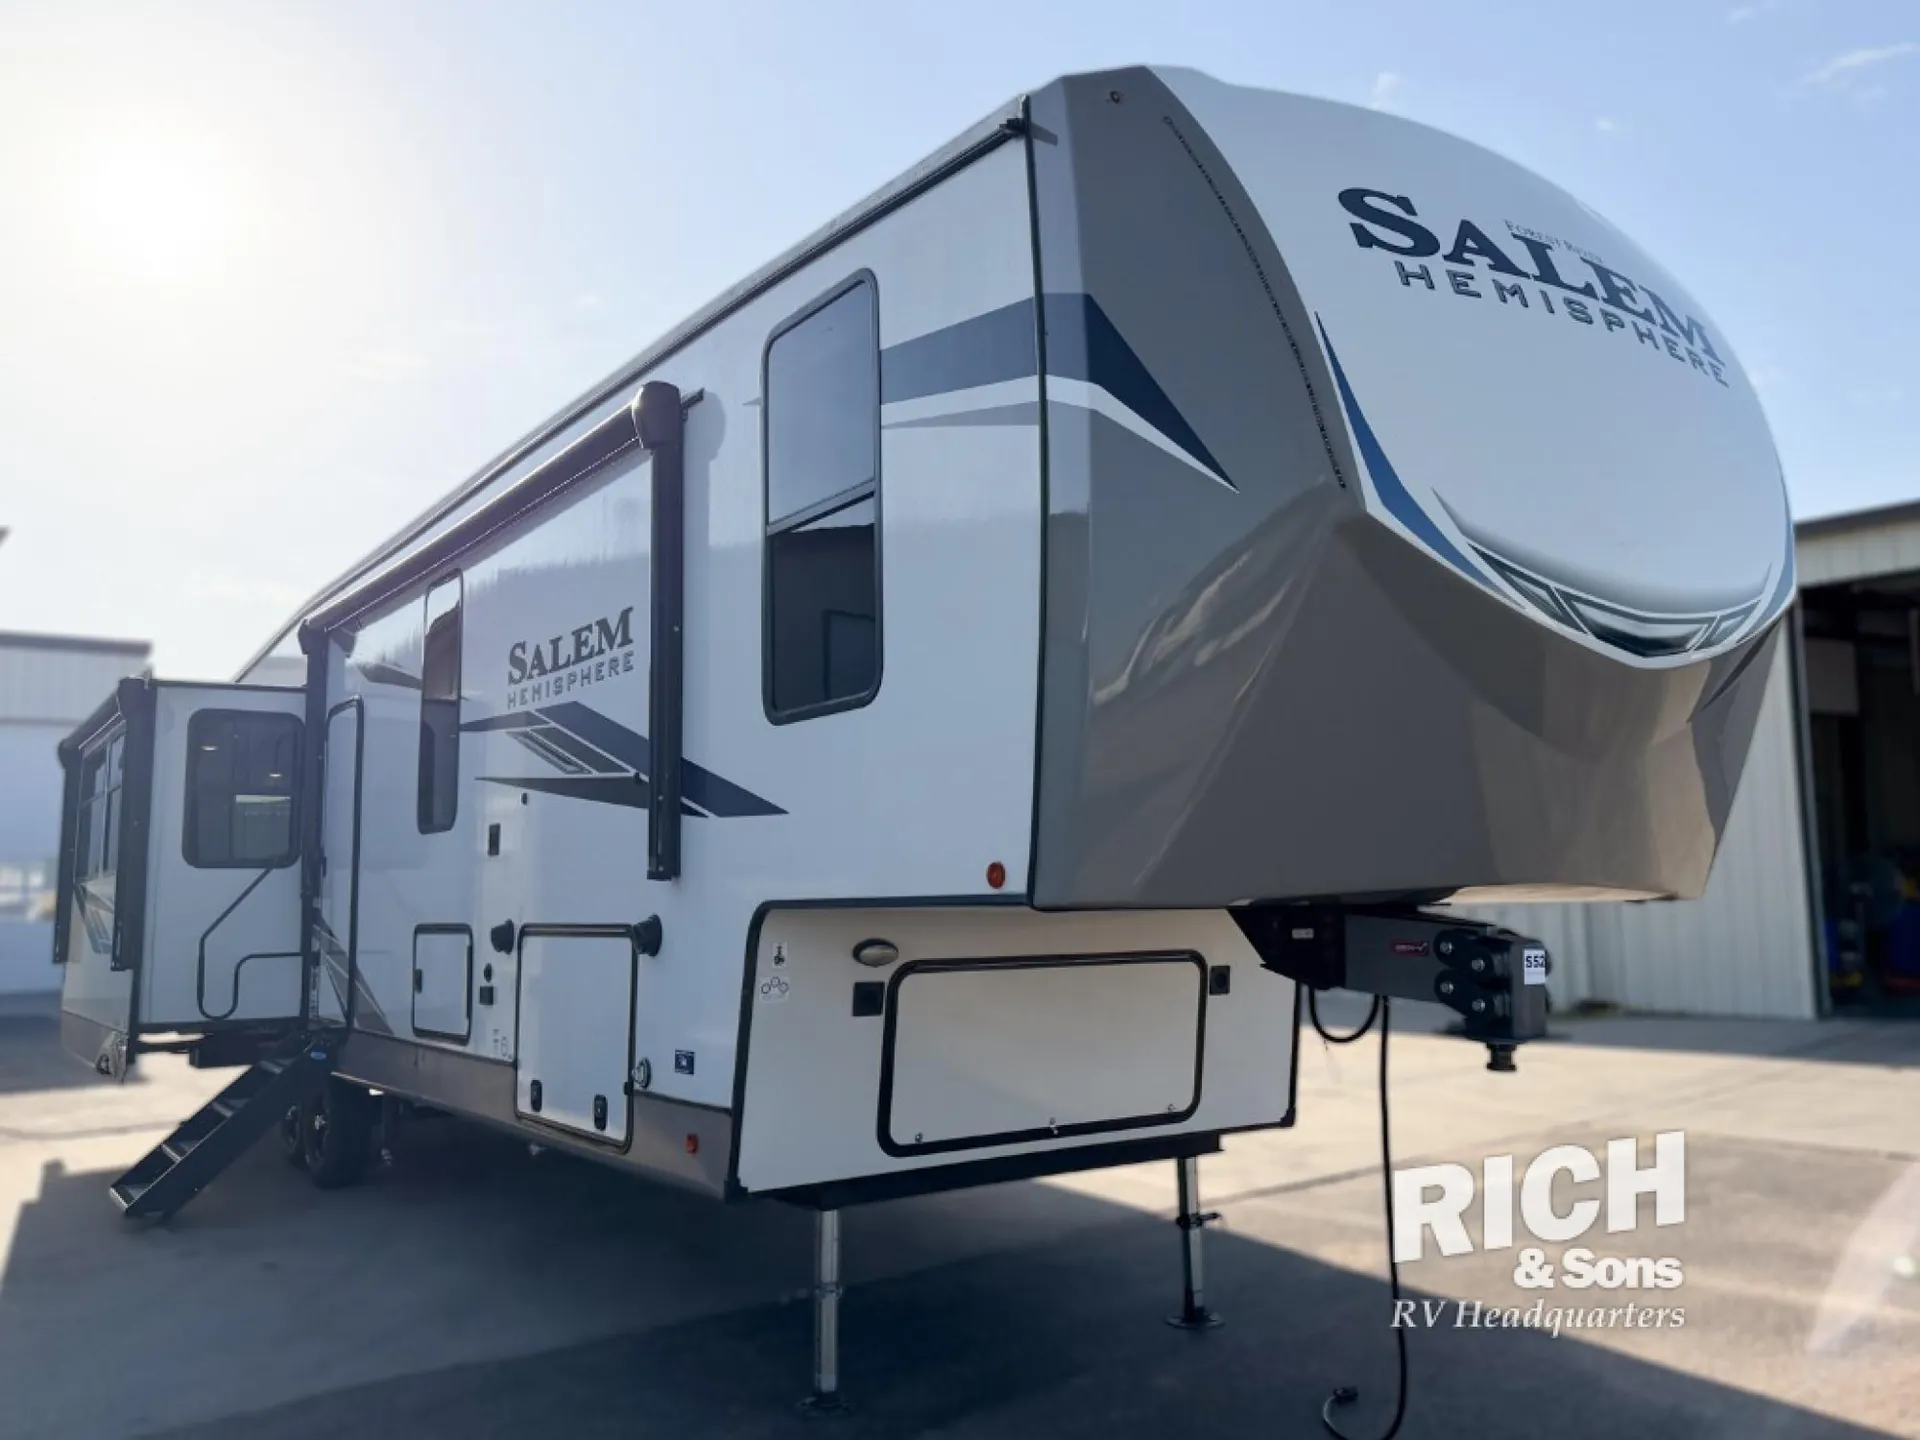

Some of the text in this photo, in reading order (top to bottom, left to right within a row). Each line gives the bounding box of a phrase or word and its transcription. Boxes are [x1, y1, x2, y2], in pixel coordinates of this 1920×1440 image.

[1338, 187, 1726, 367] SALEM
[1395, 260, 1730, 388] HEMISPHERE
[507, 650, 635, 710] HEMISPHERE
[508, 606, 634, 686] SALEM
